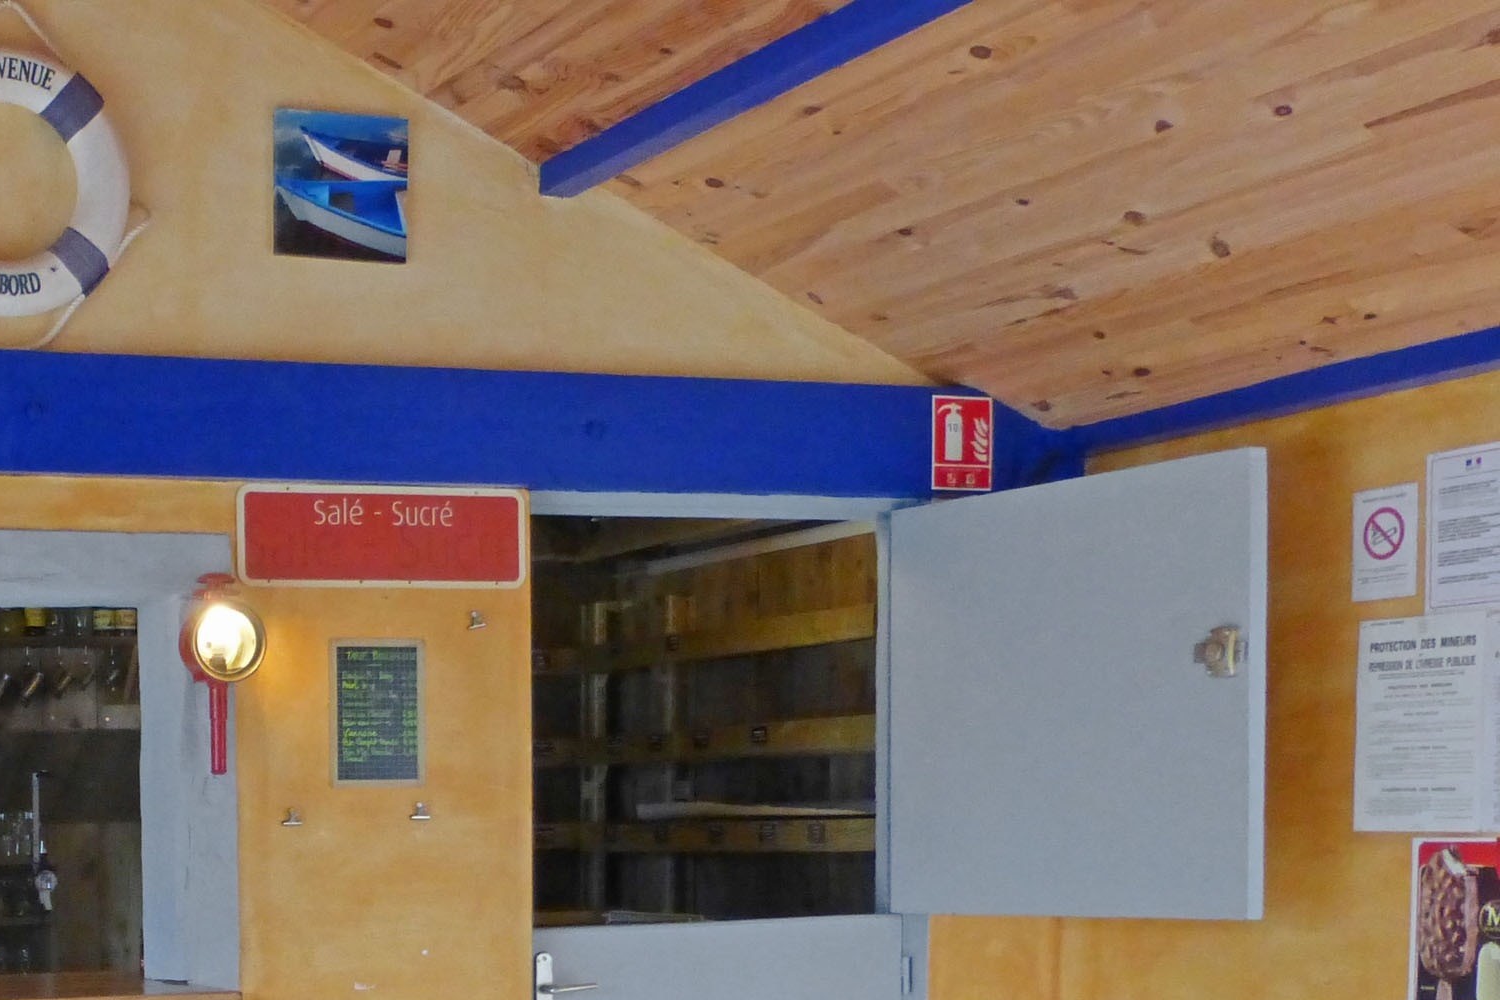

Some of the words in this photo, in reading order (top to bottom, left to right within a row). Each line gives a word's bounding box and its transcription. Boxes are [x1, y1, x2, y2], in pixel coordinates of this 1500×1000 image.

[0, 272, 41, 296] BORD
[948, 423, 959, 433] 10
[313, 498, 363, 525] Salé
[392, 501, 453, 527] Sucré
[1369, 640, 1417, 653] PROTECTION
[1420, 638, 1436, 649] DES
[1440, 635, 1477, 648] MINEURS
